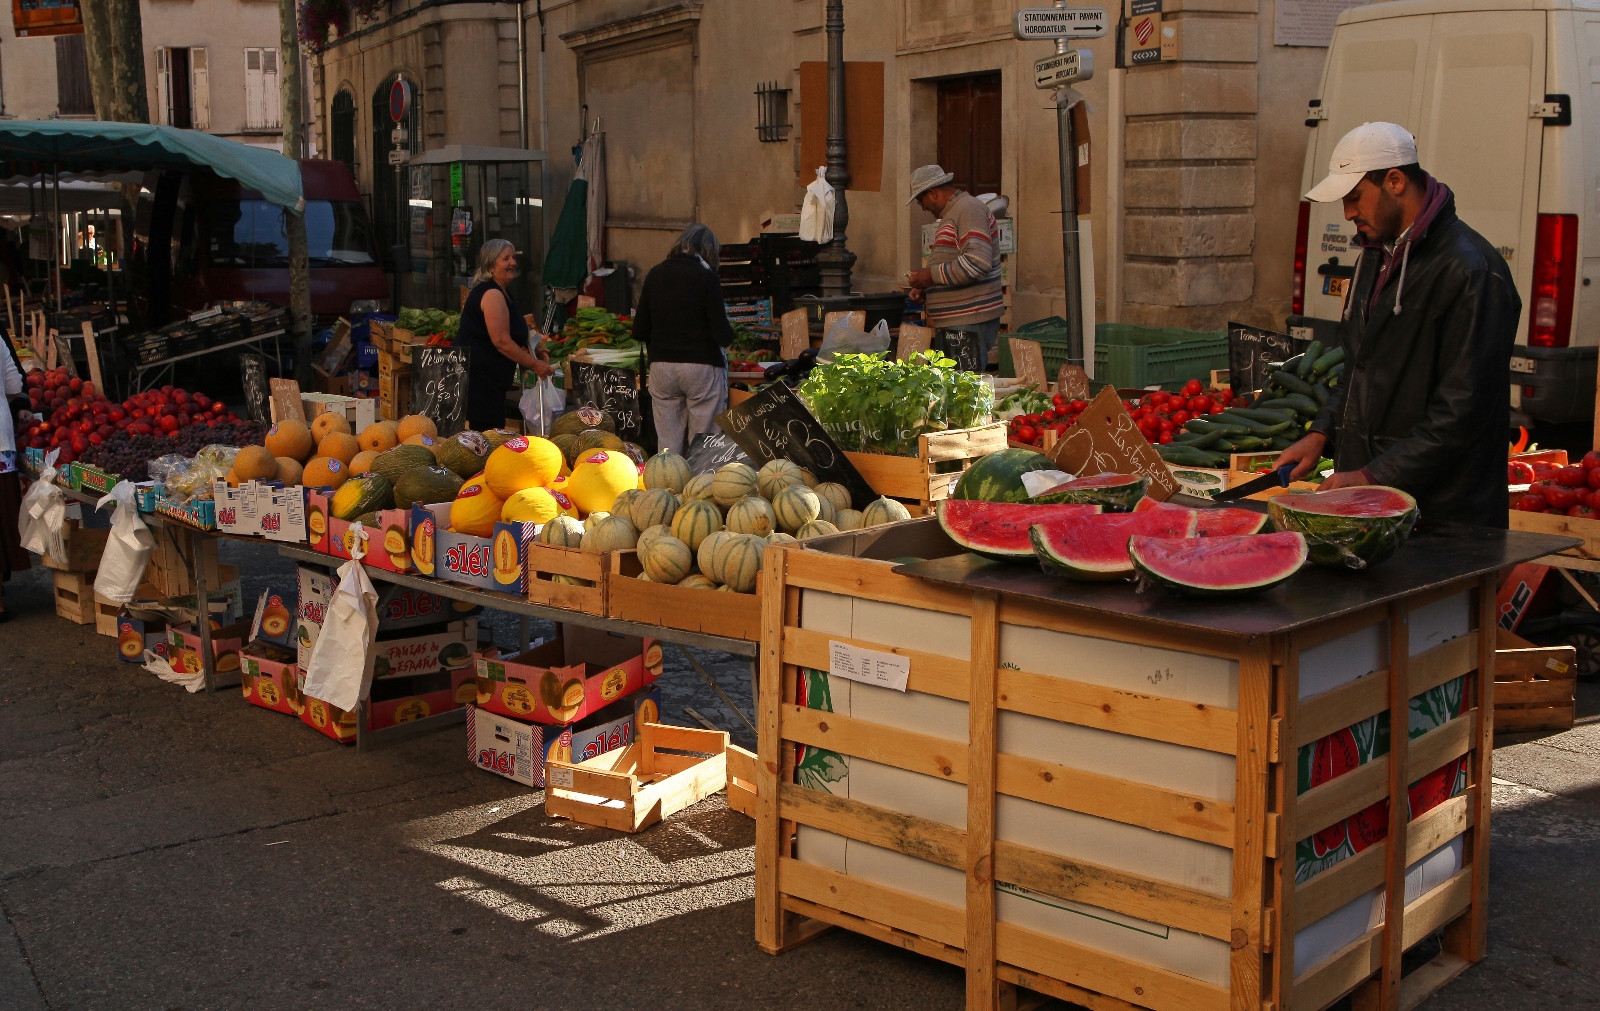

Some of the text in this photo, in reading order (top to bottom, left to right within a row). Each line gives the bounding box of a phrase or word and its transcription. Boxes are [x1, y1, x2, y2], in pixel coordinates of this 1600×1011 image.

[1024, 12, 1103, 22] STATIONNEMENT PAYANT
[1025, 25, 1067, 34] HORODATEUR
[1323, 234, 1347, 243] IVECO
[1328, 244, 1347, 252] Gruau
[618, 410, 635, 431] 98
[446, 541, 491, 578] olé!
[388, 641, 440, 660] FRUTAS de
[396, 655, 438, 673] ESPAÑA
[479, 747, 516, 777] olé!
